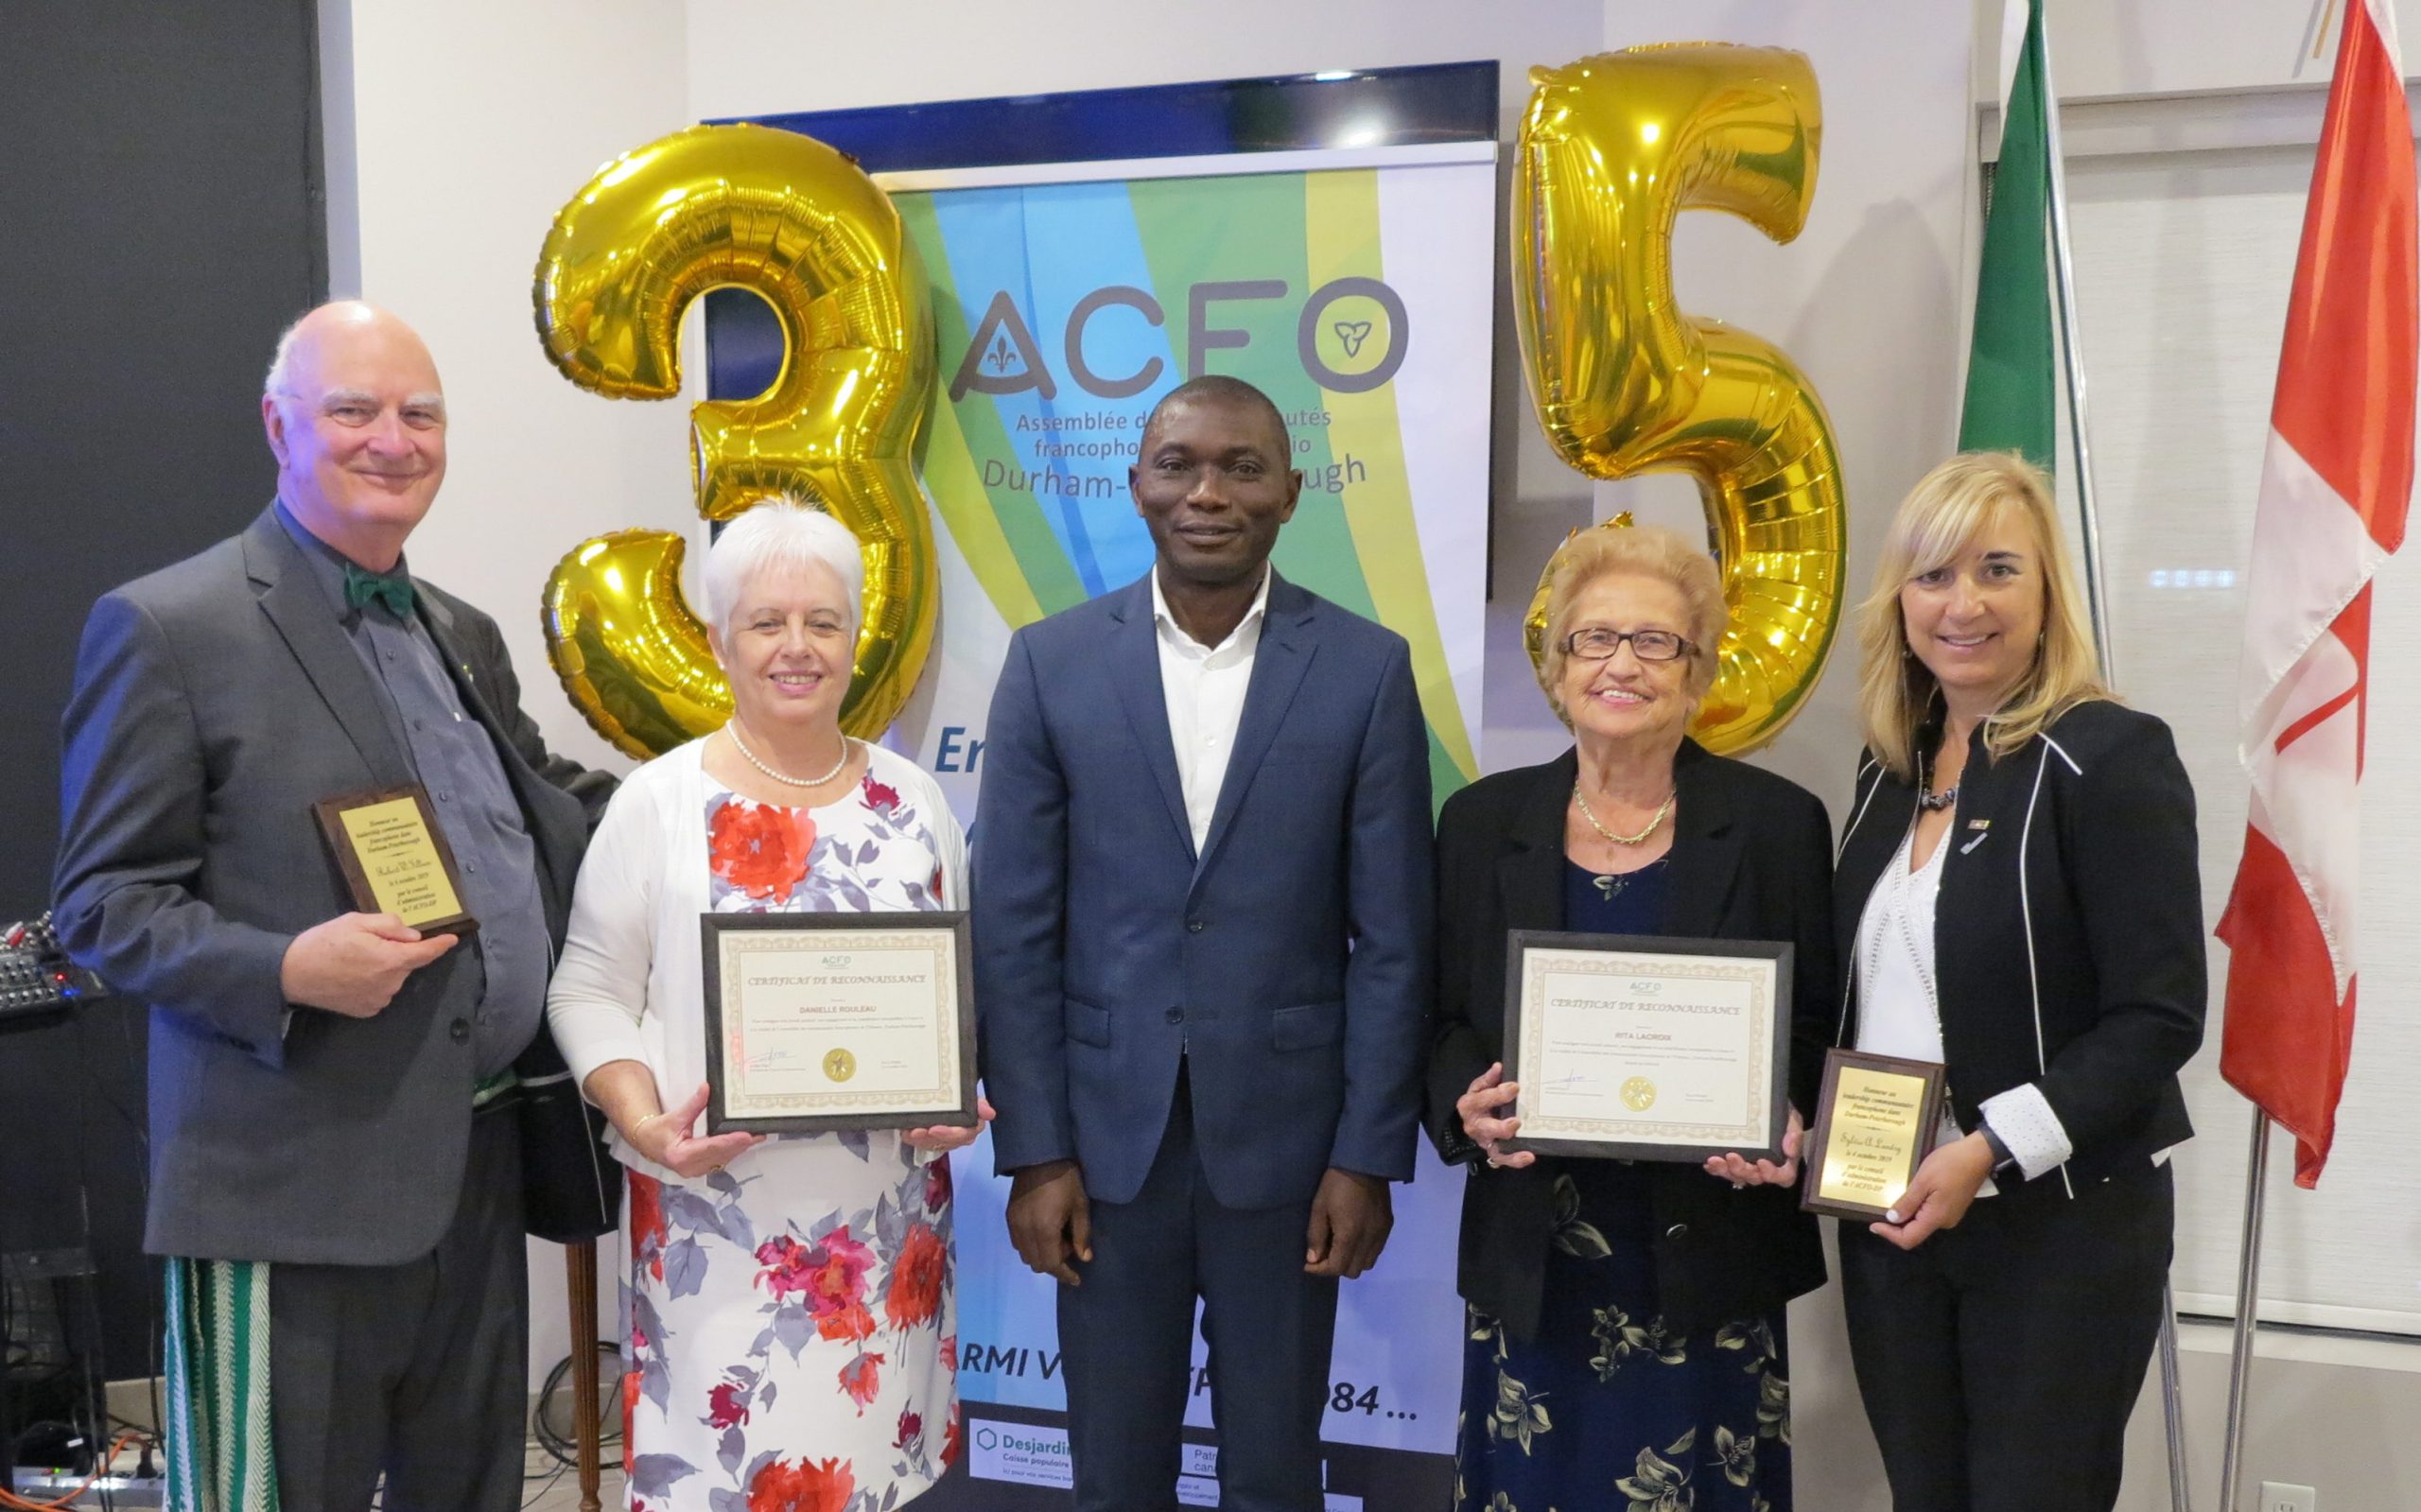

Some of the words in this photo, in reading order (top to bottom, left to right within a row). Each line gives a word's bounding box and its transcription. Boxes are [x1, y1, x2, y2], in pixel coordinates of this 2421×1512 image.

[949, 276, 1409, 403] ACFO
[1016, 410, 1128, 431] Assemblée
[1035, 438, 1139, 460] francopho
[747, 975, 812, 986] CERTIFICAT
[813, 976, 828, 985] DE
[831, 974, 927, 984] RECONNAISSANCE
[1551, 998, 1618, 1010] CERTIFICAT
[1618, 1001, 1635, 1011] DE
[1637, 1002, 1741, 1016] RECONNAISSANCE
[957, 1343, 1029, 1377] RMI
[1329, 1382, 1380, 1416] 84
[1002, 1434, 1071, 1456] Desjardi
[1002, 1452, 1029, 1464] Caisse
[1031, 1457, 1070, 1469] populaire
